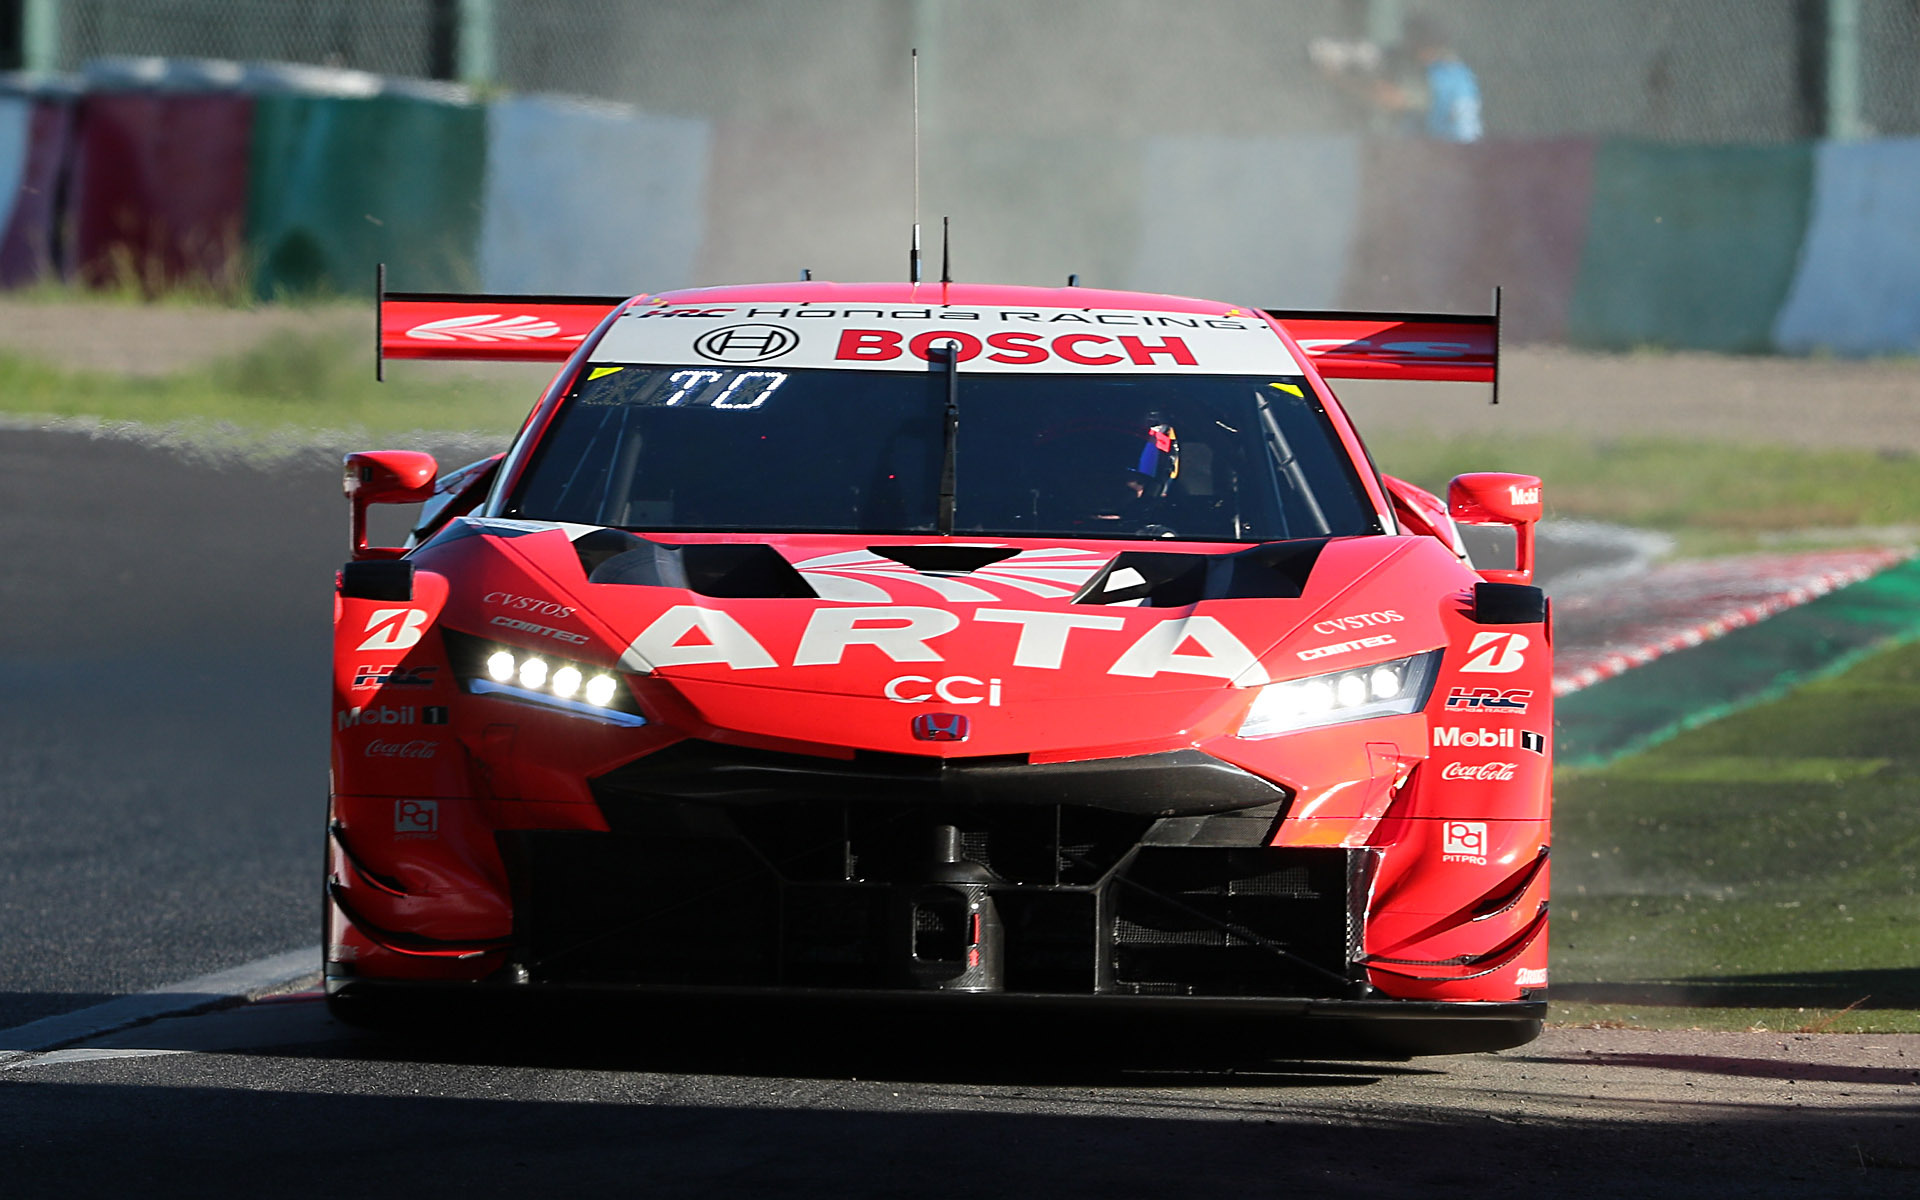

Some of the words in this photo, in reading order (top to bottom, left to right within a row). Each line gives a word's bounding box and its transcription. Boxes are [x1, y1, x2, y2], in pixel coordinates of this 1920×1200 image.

[746, 308, 980, 320] Honda
[999, 310, 1248, 330] RACING
[834, 329, 1199, 367] BOSCH
[483, 591, 577, 619] CVSTOS
[490, 616, 590, 646] COMTEC
[1313, 609, 1405, 635] CVSTOS
[615, 604, 1271, 688] ARTA
[1296, 634, 1397, 662] COMTEC
[884, 675, 1002, 707] CCi
[1445, 686, 1534, 710] HRC
[338, 704, 415, 731] Mobil
[1433, 726, 1515, 748] Mobil
[1442, 854, 1487, 866] PITPRO
